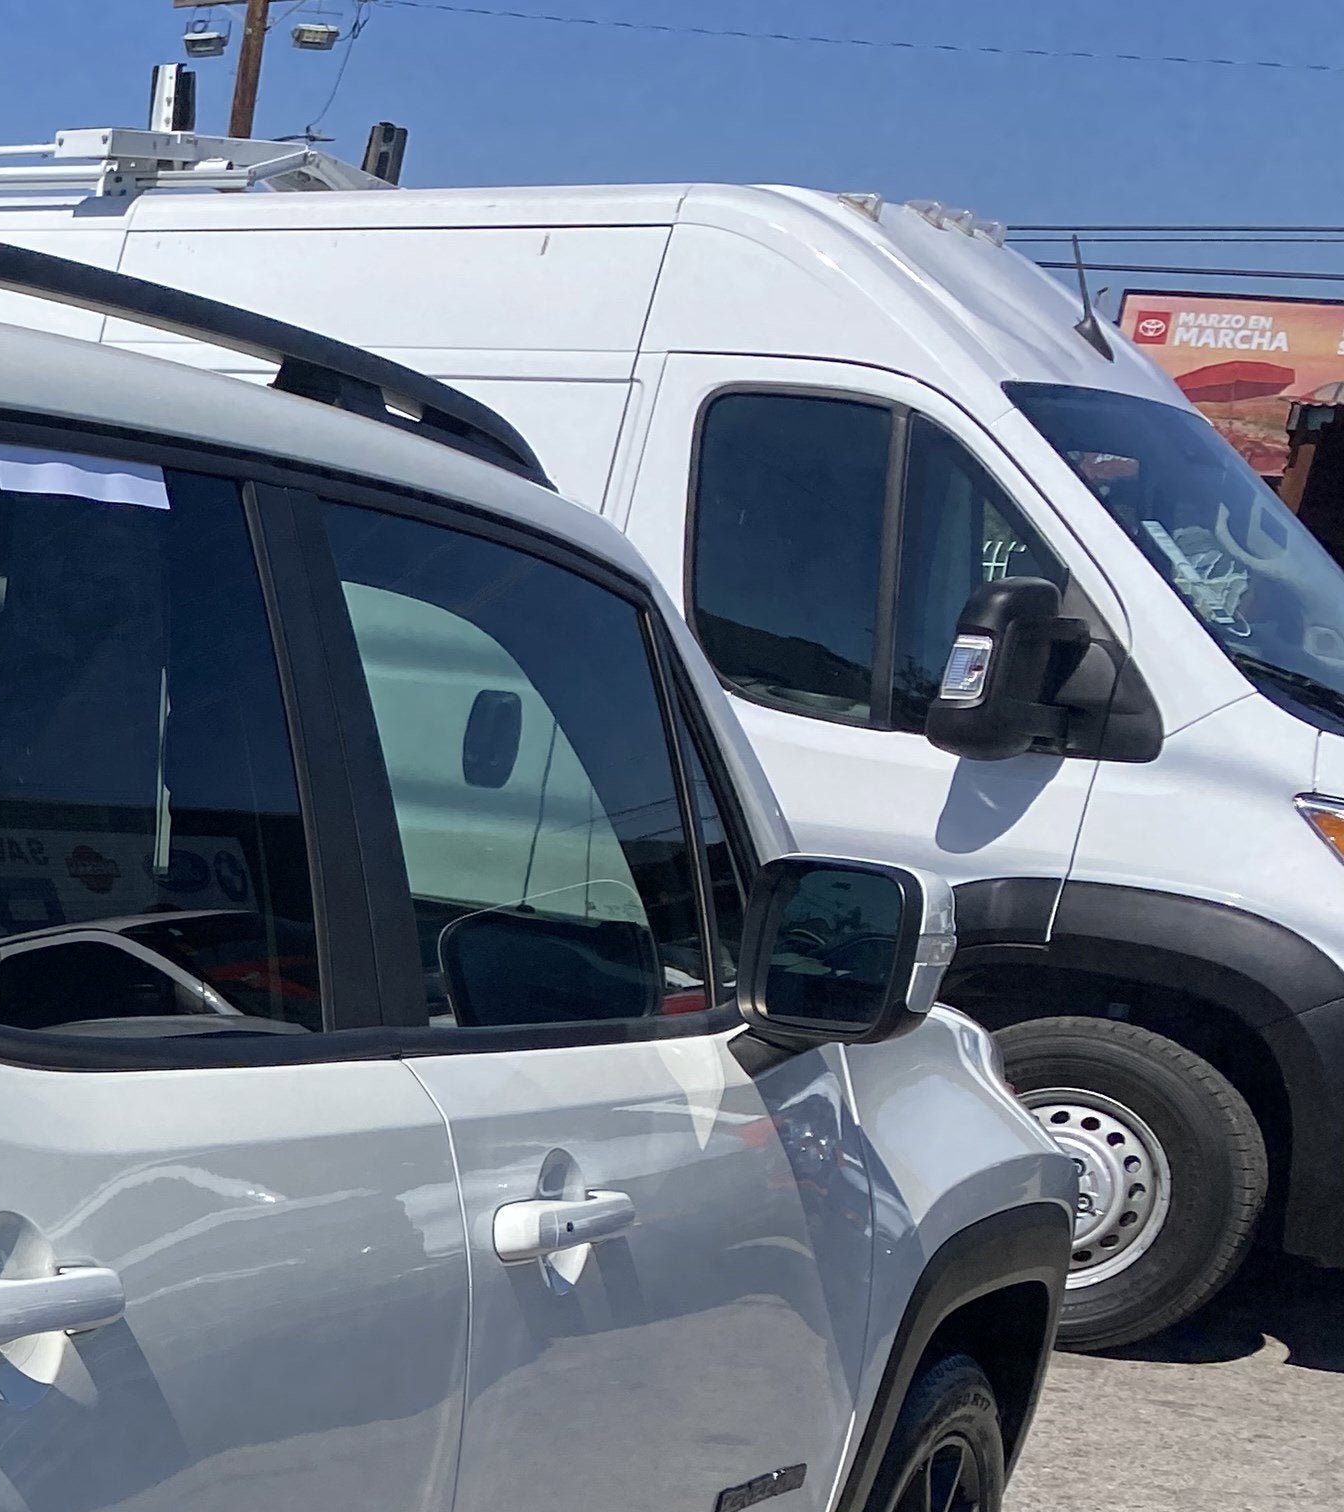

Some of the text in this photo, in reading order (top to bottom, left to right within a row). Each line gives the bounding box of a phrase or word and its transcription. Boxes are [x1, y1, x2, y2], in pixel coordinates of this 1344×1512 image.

[1178, 311, 1274, 330] MARZO EN
[1173, 326, 1289, 353] MARCHA
